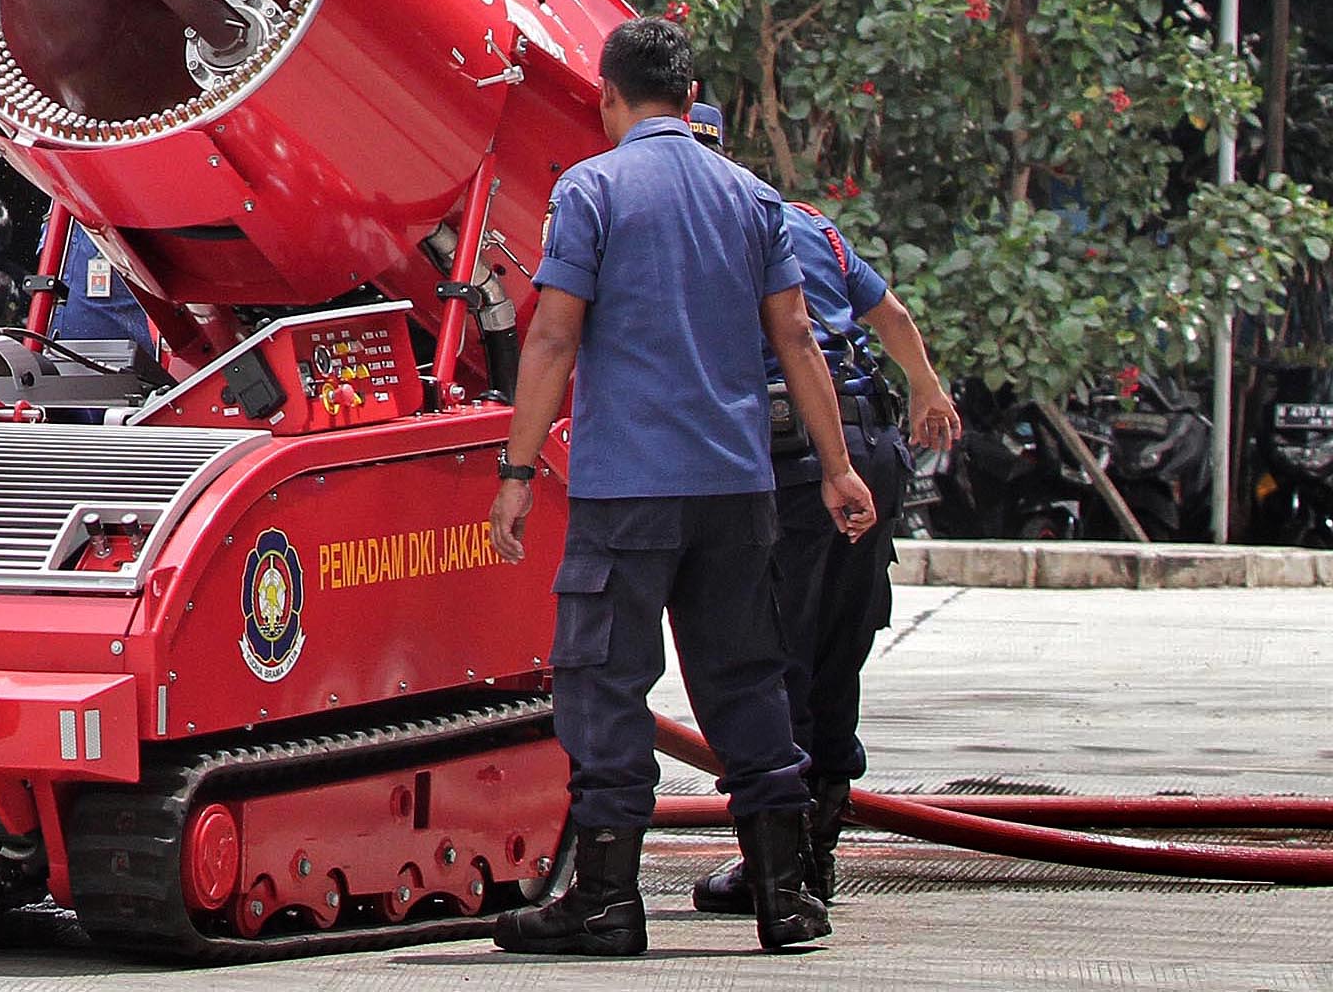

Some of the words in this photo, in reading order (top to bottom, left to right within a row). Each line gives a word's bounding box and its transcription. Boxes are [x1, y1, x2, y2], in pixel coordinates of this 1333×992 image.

[319, 534, 405, 590] PEMADAM
[408, 529, 435, 578] DKI
[439, 520, 515, 573] JAKAR
